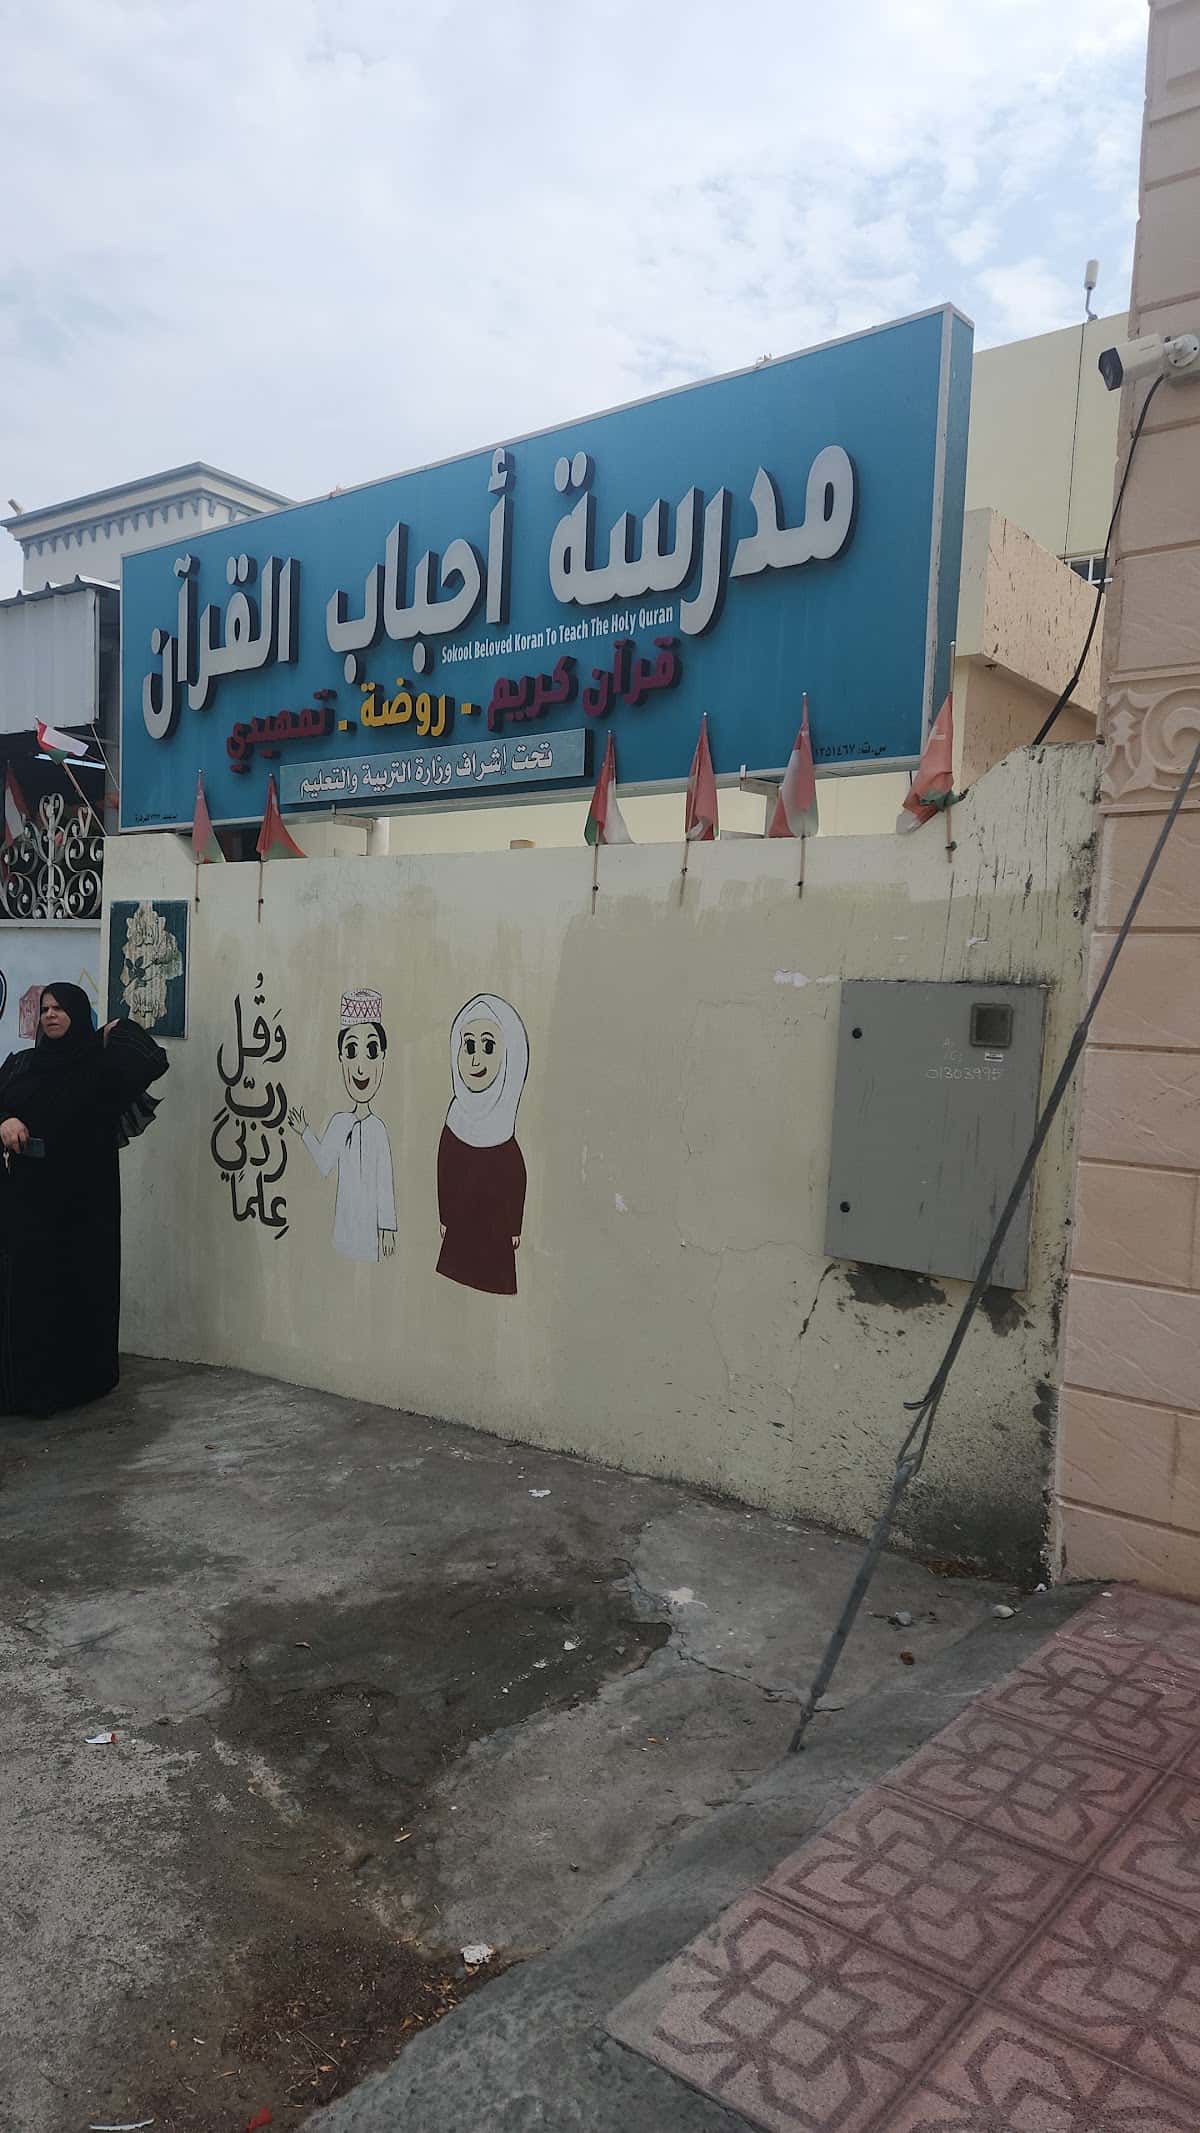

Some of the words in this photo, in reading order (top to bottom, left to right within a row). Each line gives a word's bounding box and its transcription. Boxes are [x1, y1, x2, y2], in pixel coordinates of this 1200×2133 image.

[326, 448, 511, 685] أحباب
[549, 445, 856, 636] مدرسة
[143, 553, 298, 740] القرآن
[441, 641, 473, 664] Sokool
[474, 637, 512, 659] Beloved
[514, 632, 544, 652] Koran
[546, 627, 558, 646] To
[559, 622, 589, 643] Teach
[590, 616, 610, 637] The
[611, 611, 637, 635] Holy
[638, 606, 673, 629] Quran
[487, 656, 574, 732] كريم
[582, 636, 678, 717] قرآن
[226, 688, 335, 774] تمهيدي
[360, 677, 447, 737] روضة
[299, 767, 358, 800] والتعليم
[361, 760, 411, 793] التربية
[415, 752, 452, 785] وزارة
[455, 745, 507, 781] إشراف
[511, 741, 553, 771] تحت
